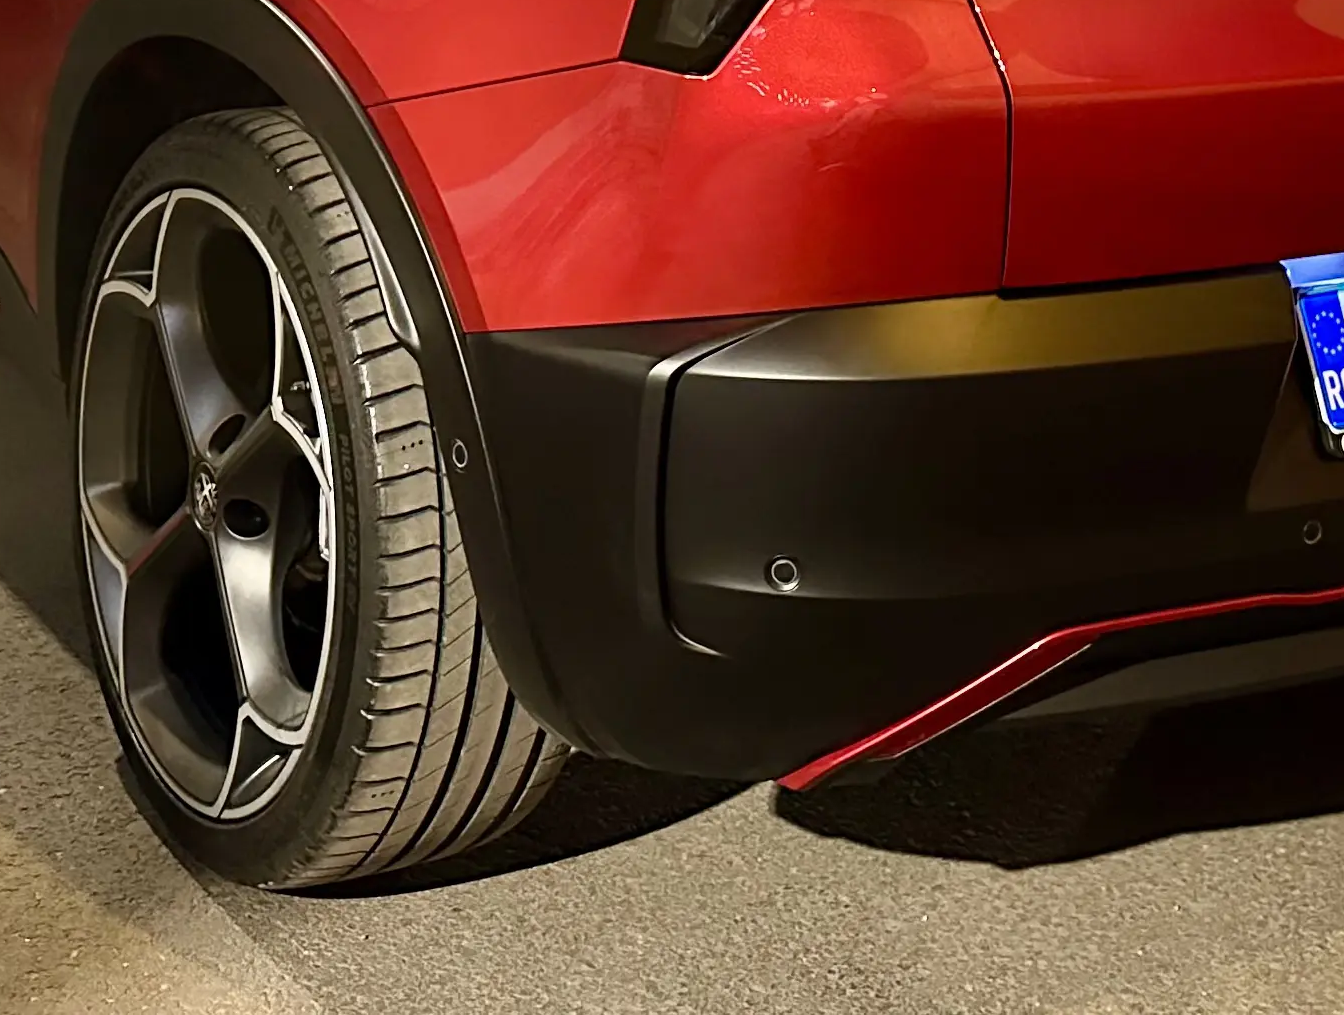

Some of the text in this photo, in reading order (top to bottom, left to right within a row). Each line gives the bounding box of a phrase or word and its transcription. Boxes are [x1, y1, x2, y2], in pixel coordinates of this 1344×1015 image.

[281, 239, 346, 407] MICHELIN
[338, 432, 356, 498] PILOT
[345, 501, 358, 578] SPORT
